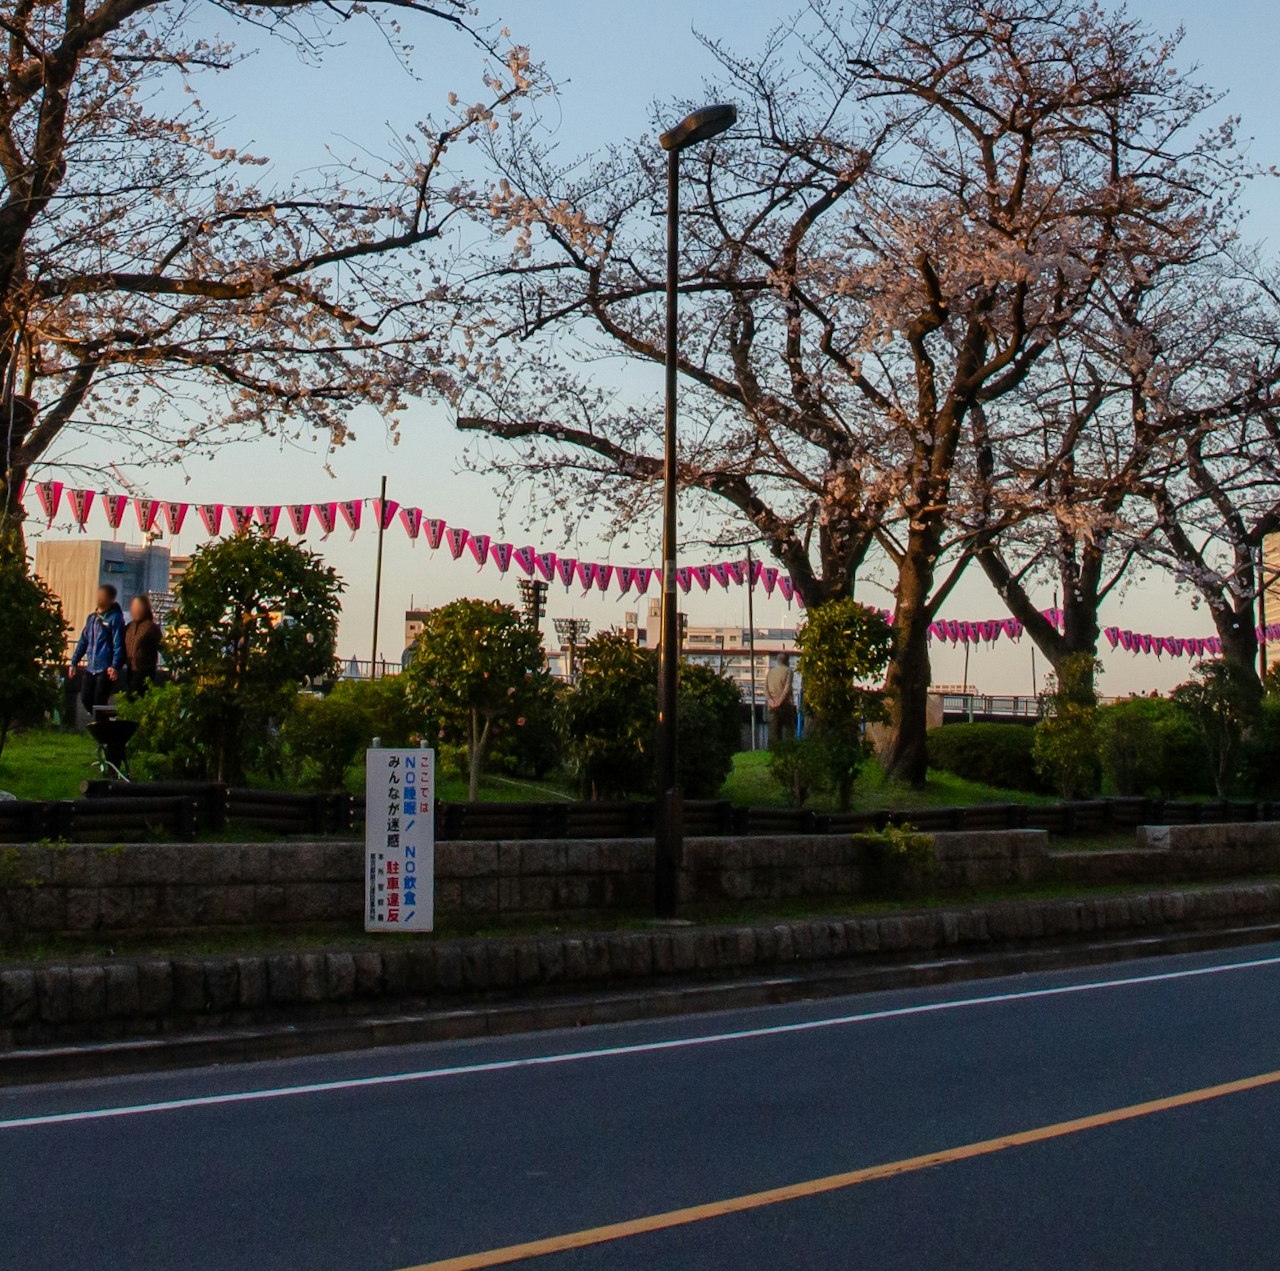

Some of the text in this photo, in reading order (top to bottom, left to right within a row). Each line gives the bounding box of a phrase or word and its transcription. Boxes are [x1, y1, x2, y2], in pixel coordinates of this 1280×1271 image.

[386, 756, 400, 923] みんなが迷惑 駐車違反
